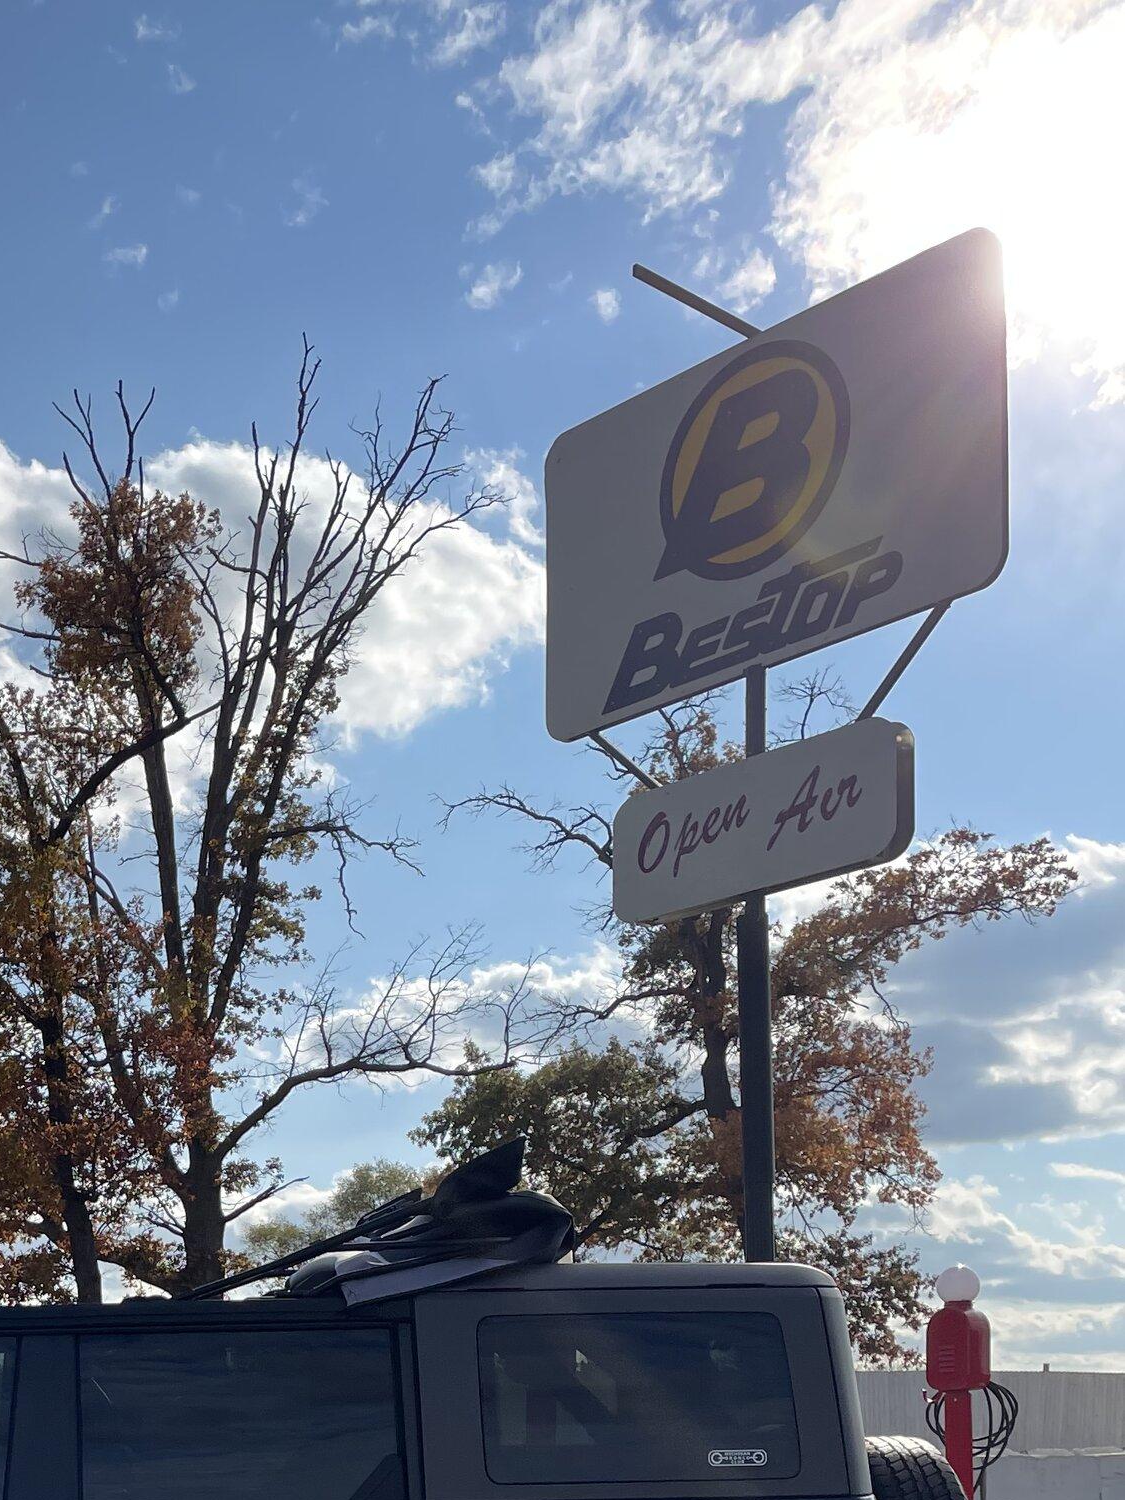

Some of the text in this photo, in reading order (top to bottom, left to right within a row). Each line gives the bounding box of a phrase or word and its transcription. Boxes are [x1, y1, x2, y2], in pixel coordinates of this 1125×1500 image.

[654, 362, 827, 582] B
[638, 765, 862, 877] Open Air
